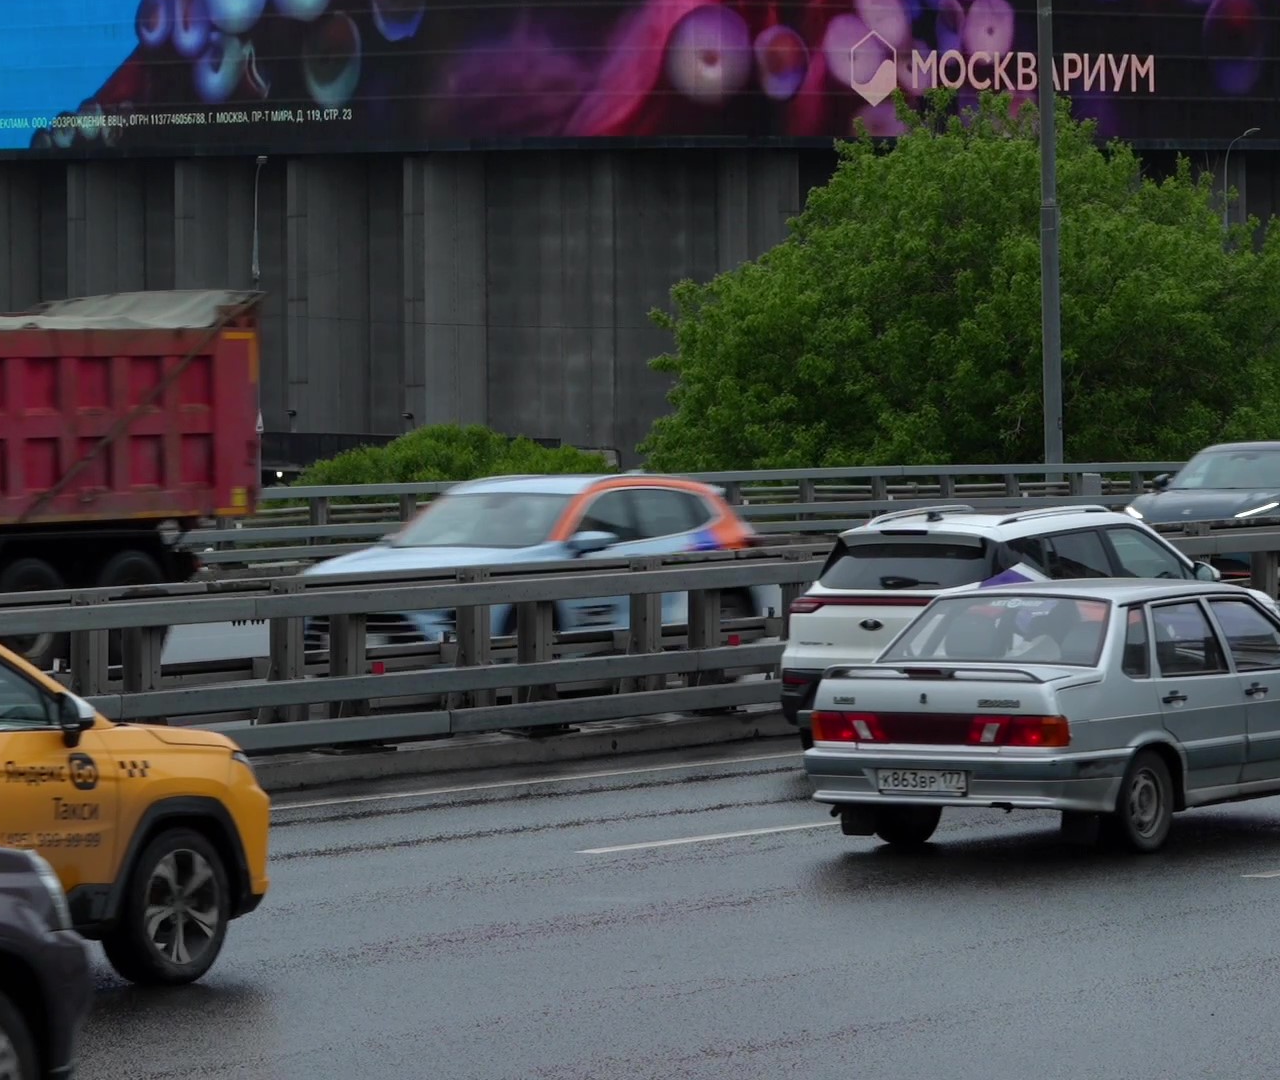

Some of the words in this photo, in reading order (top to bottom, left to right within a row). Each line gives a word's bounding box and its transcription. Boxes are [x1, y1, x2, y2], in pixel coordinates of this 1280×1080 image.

[912, 49, 1155, 92] МОСКВРИУМ
[32, 117, 47, 128] ООО
[130, 114, 149, 126] ОГРН
[251, 110, 269, 122] ПР-Т
[323, 108, 341, 120] СТР.
[342, 108, 352, 120] 23
[52, 796, 100, 821] Такси
